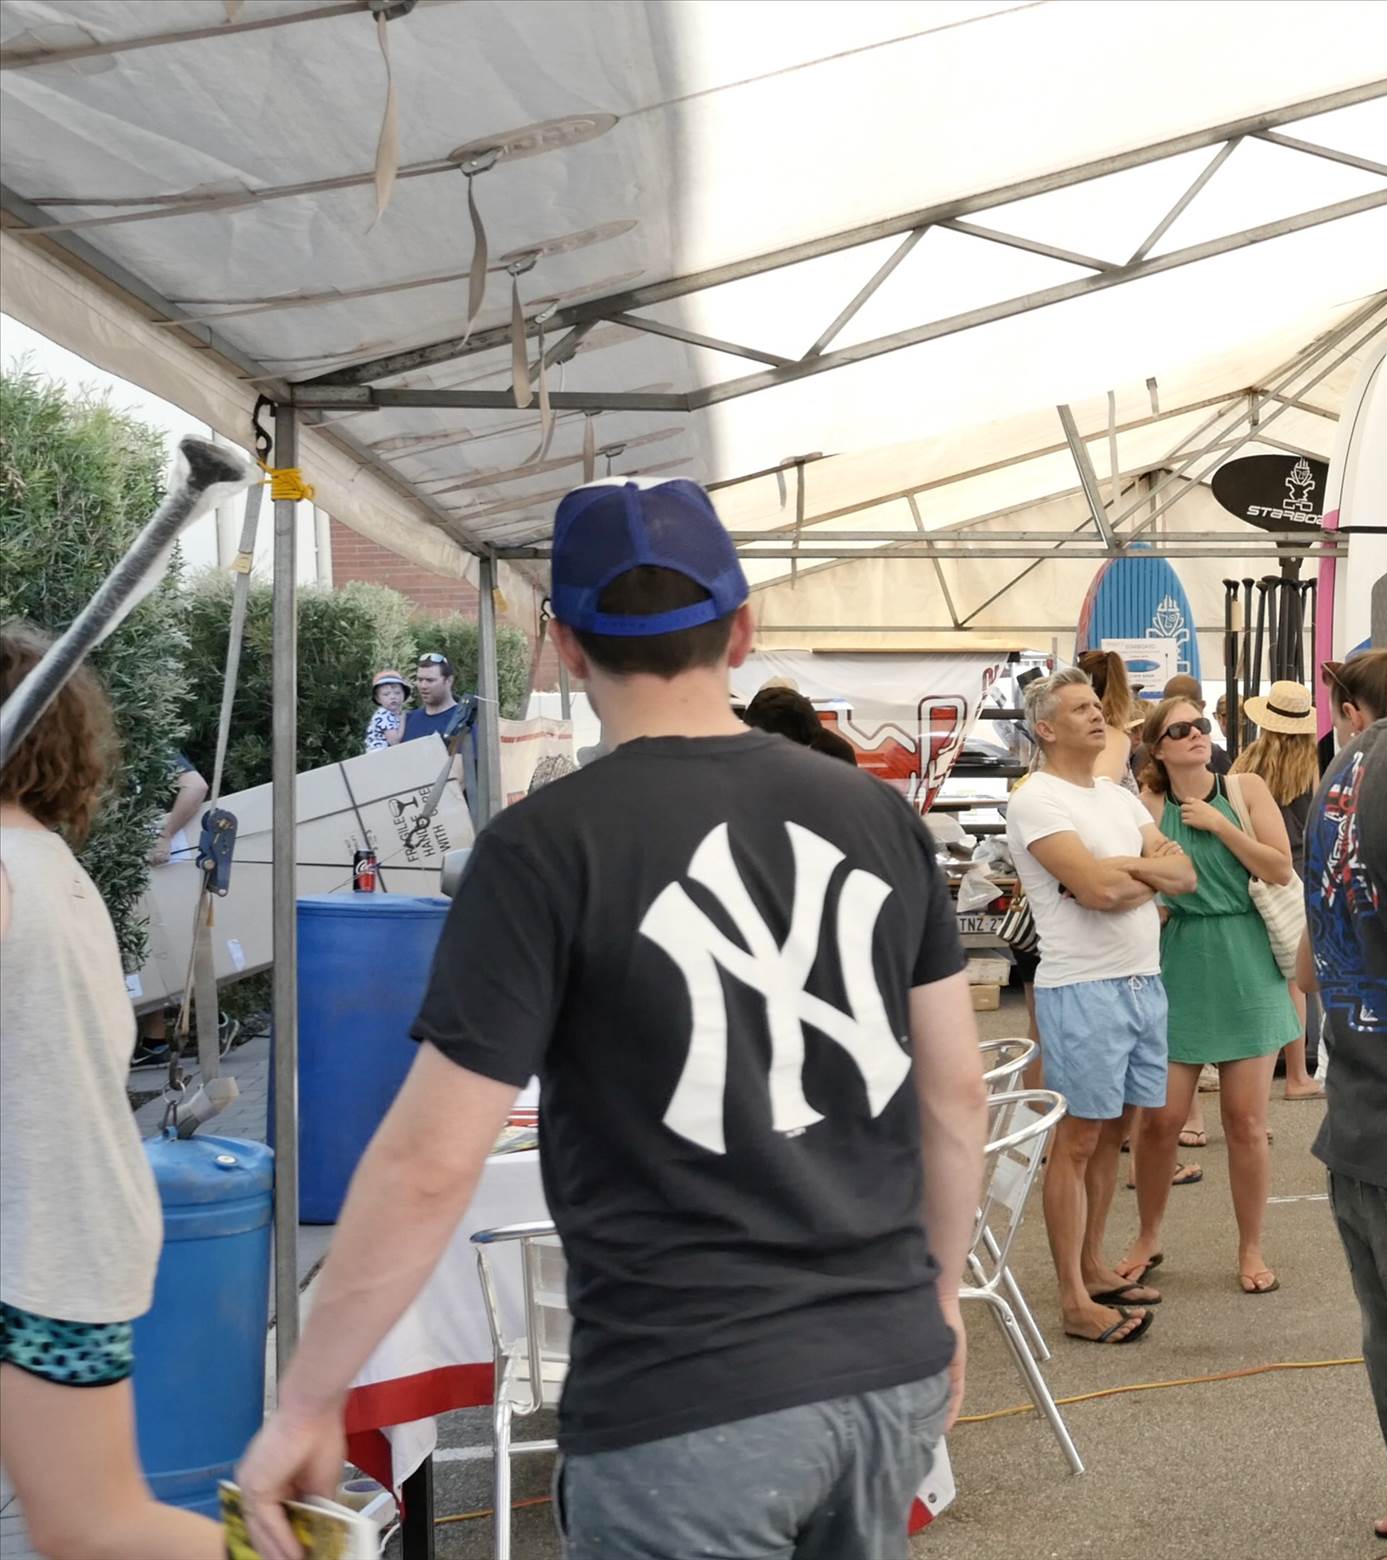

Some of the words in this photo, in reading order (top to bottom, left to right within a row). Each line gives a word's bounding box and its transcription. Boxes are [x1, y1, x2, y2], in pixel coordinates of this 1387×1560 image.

[1246, 504, 1324, 526] STARBOA
[420, 787, 439, 817] CRE
[393, 816, 419, 863] FRGILE
[410, 815, 436, 857] HANE
[432, 824, 451, 853] WITH
[960, 918, 984, 932] TNZ
[638, 820, 913, 1155] NY
